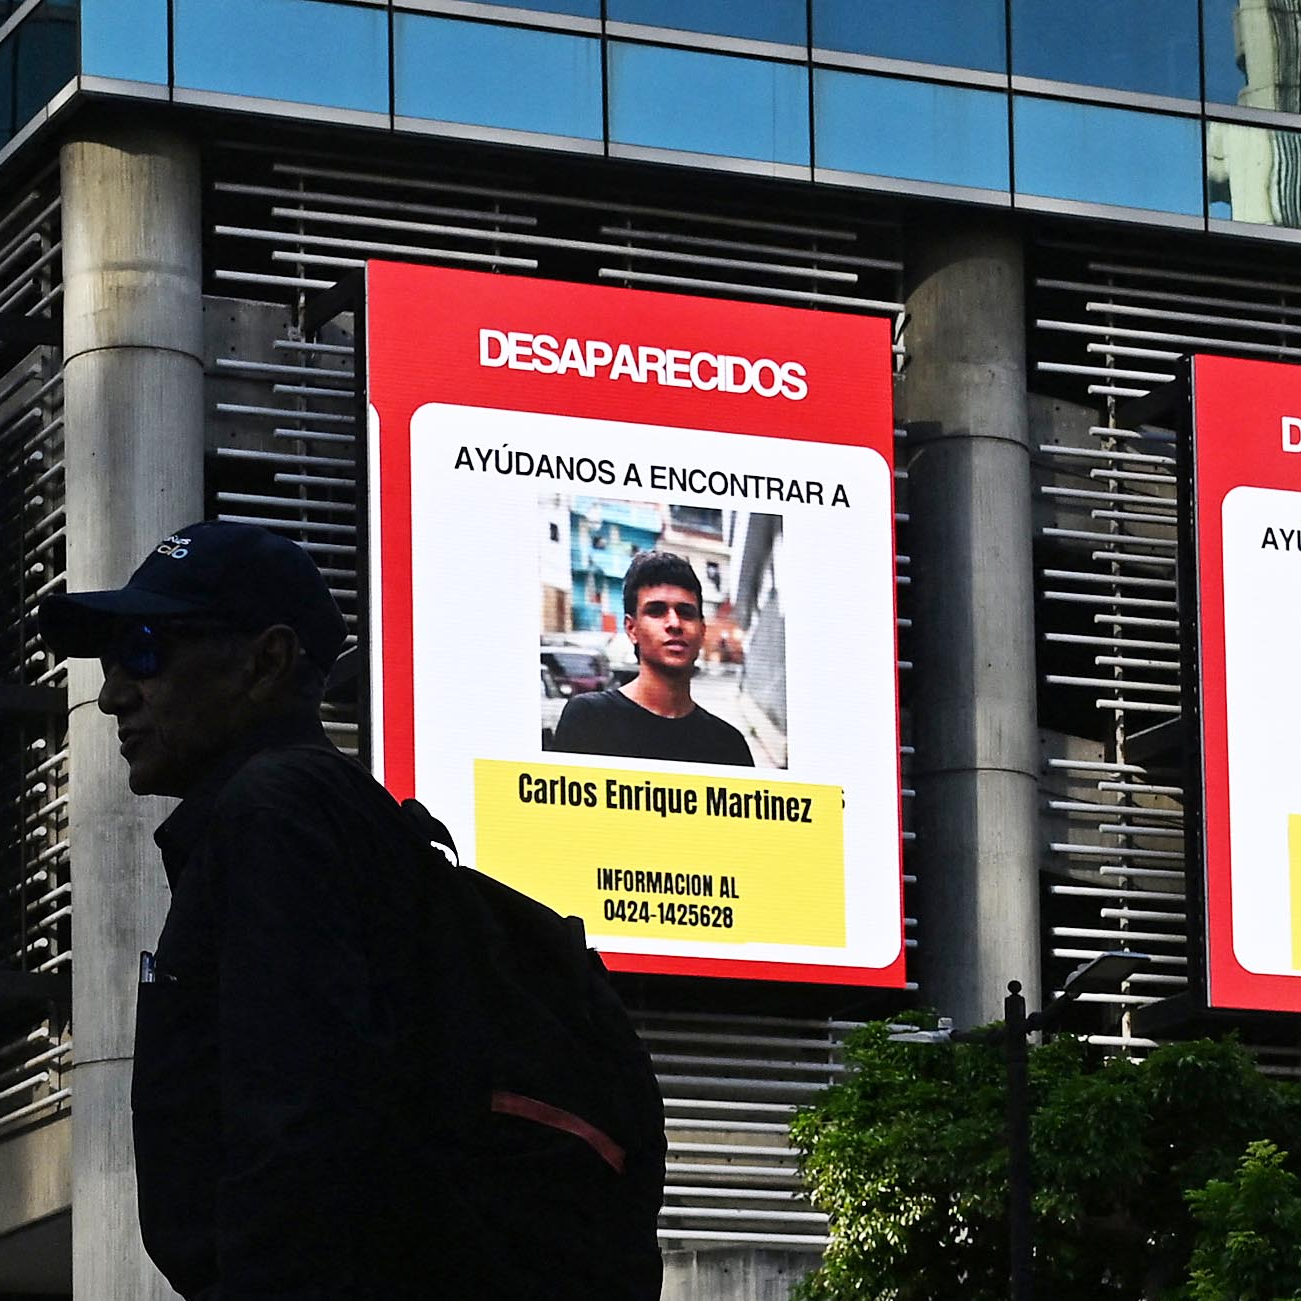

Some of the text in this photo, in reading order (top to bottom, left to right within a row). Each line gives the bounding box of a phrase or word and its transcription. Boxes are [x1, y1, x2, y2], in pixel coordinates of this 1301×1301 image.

[478, 328, 809, 401] DESAPARECIDOS
[454, 443, 851, 508] AYÚDANOS A ENCONTRAR A
[518, 773, 813, 823] Carlos Enrique Martinez
[597, 867, 740, 899] INFORMACION AL
[603, 899, 734, 929] 0424-1425628
